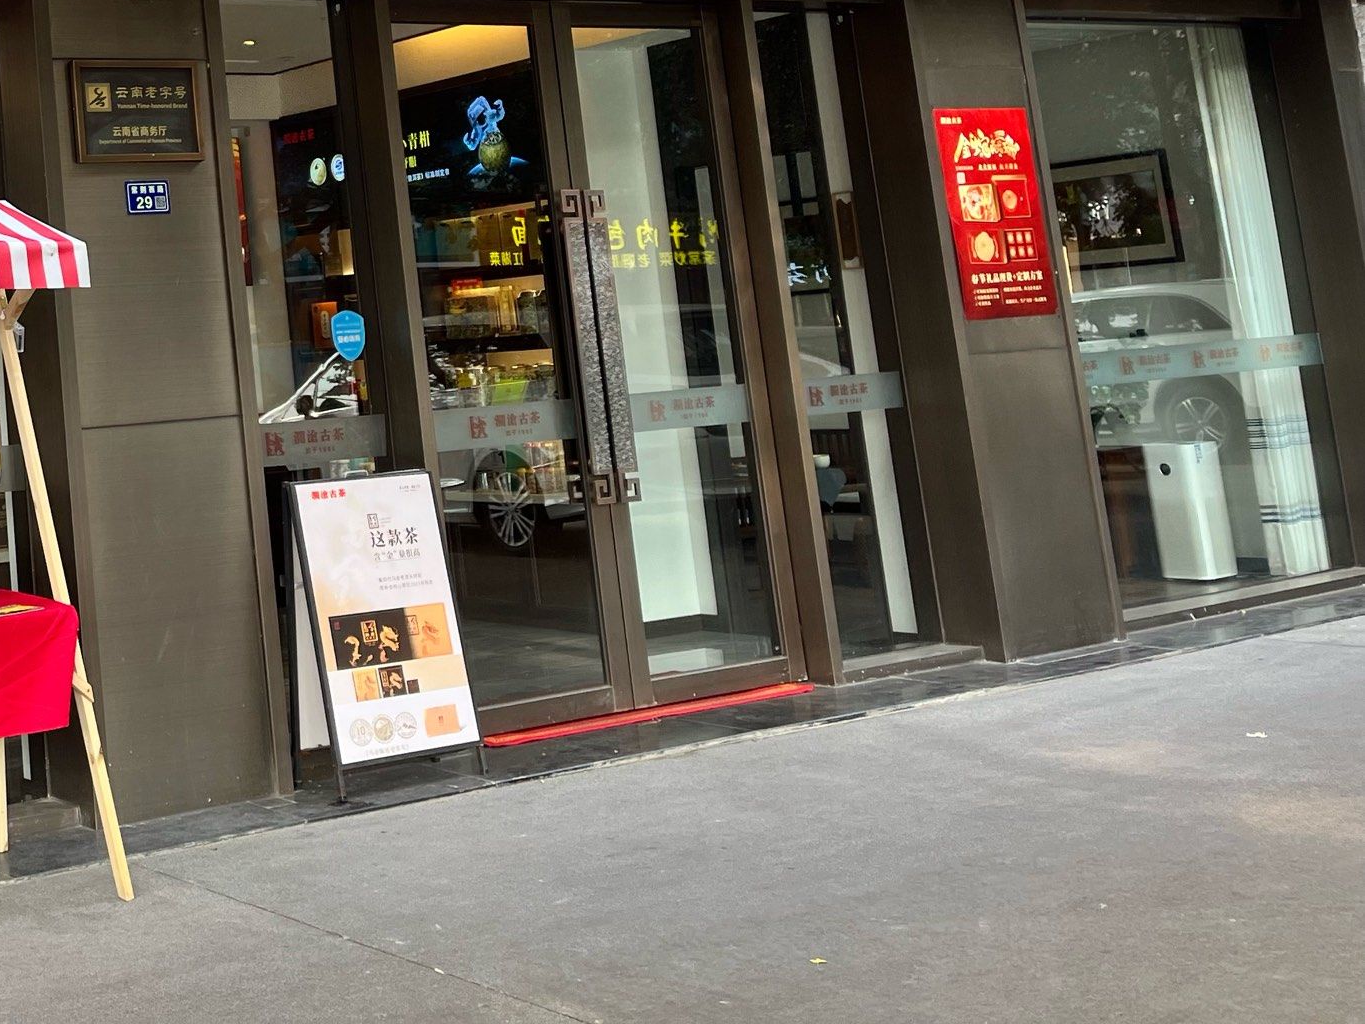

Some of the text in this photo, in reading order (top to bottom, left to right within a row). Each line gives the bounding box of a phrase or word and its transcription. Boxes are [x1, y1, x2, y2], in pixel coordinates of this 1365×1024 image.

[115, 86, 187, 99] 云南老字号
[112, 125, 167, 137] 云南省商务厅
[136, 195, 153, 210] 29
[371, 527, 419, 549] 这款茶
